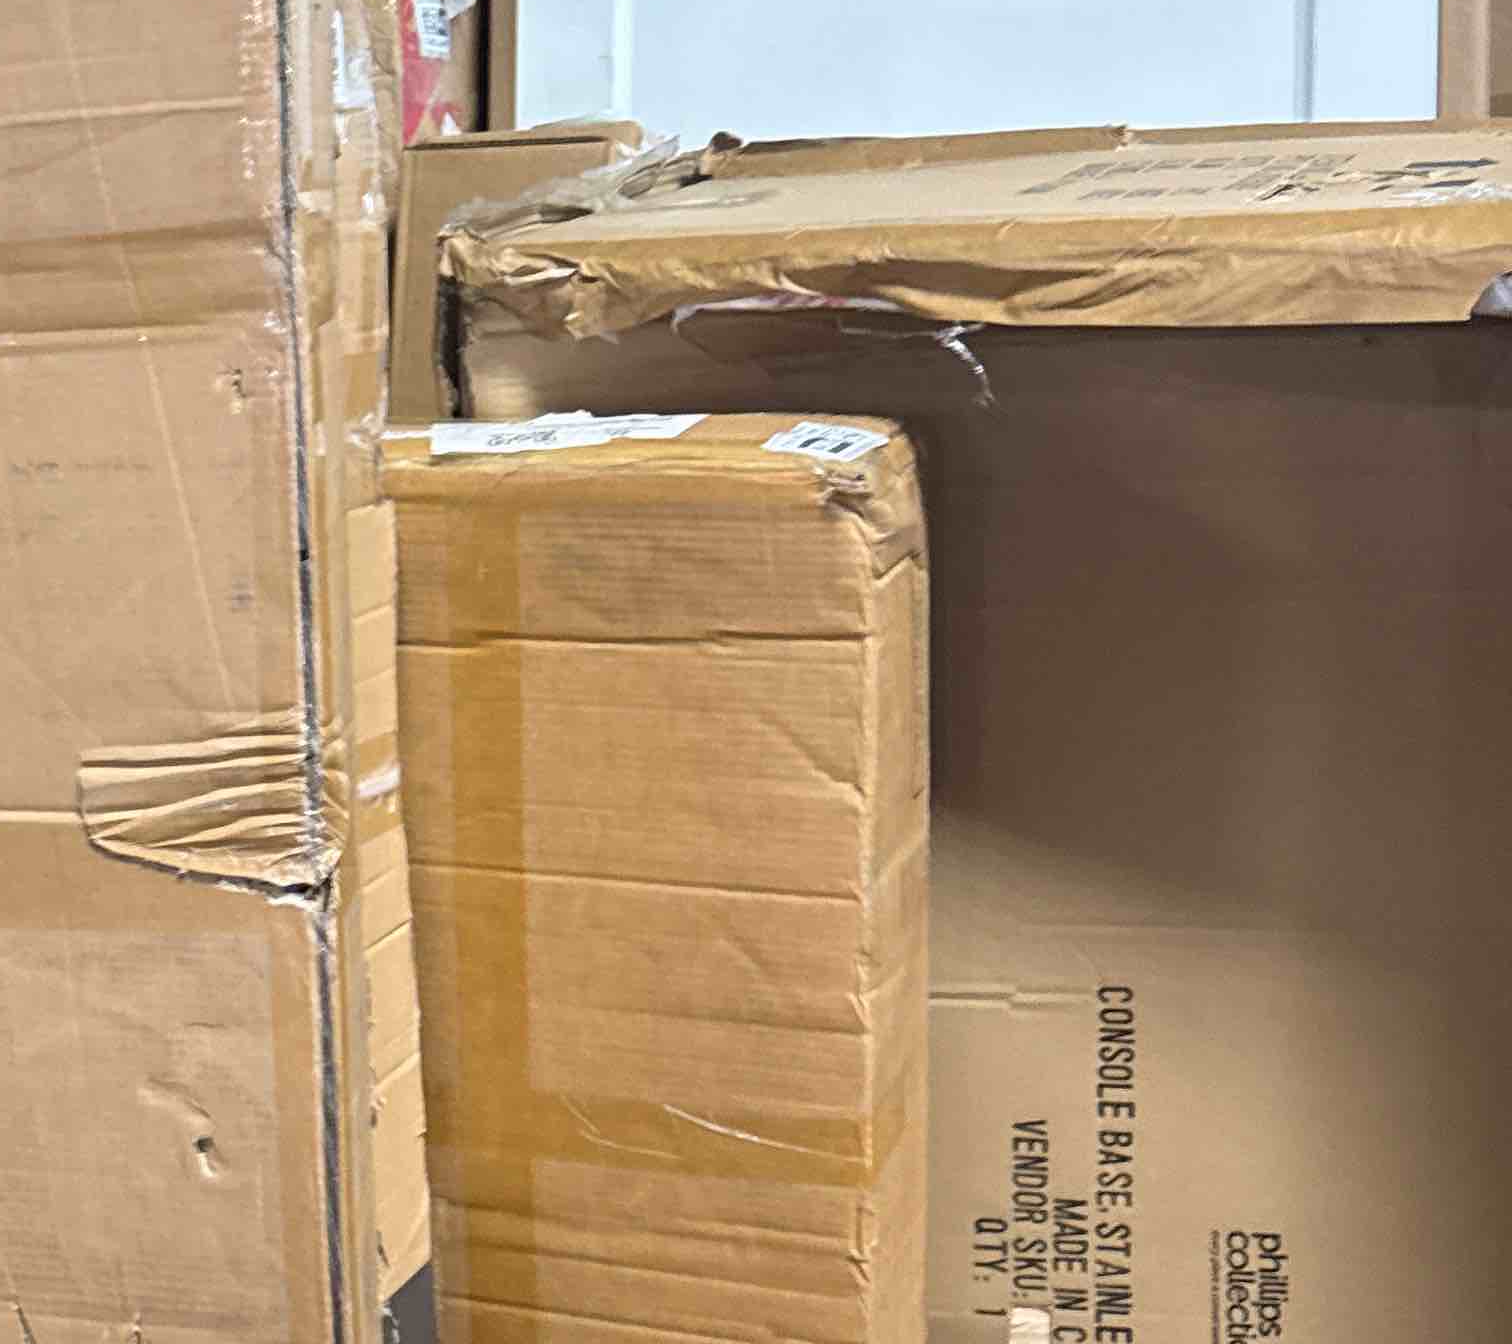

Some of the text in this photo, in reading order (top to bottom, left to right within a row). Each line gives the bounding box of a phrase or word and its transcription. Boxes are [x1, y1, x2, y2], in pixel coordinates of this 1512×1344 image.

[1096, 985, 1136, 1120] CONSOLE
[1011, 1119, 1049, 1299] VENDOR SKU:
[1052, 1198, 1089, 1274] MADE
[972, 1216, 1009, 1317] QTY: 1
[1053, 1286, 1089, 1312] IN
[1251, 1231, 1289, 1337] phillips
